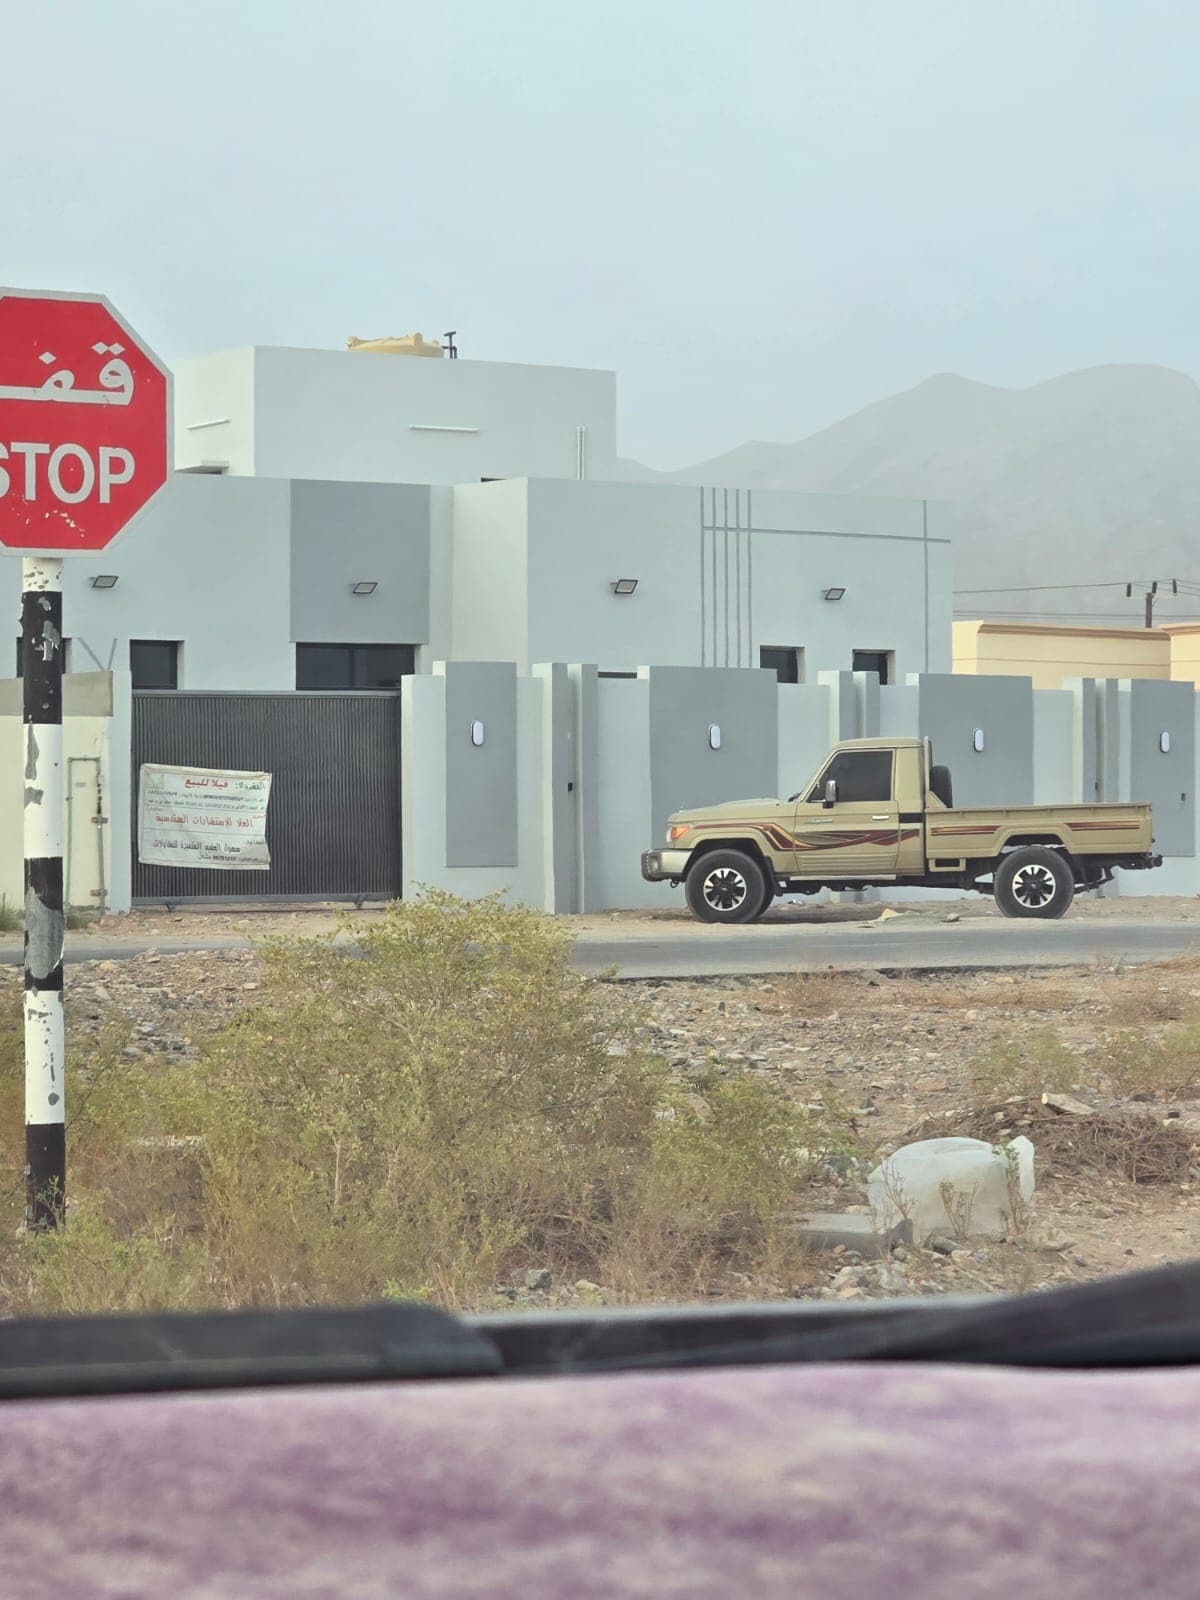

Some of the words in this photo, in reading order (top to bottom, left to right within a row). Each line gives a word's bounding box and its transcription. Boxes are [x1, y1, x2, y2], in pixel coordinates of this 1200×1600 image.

[0, 441, 136, 504] TOP
[184, 778, 210, 789] للبيع
[211, 780, 228, 790] فيلا
